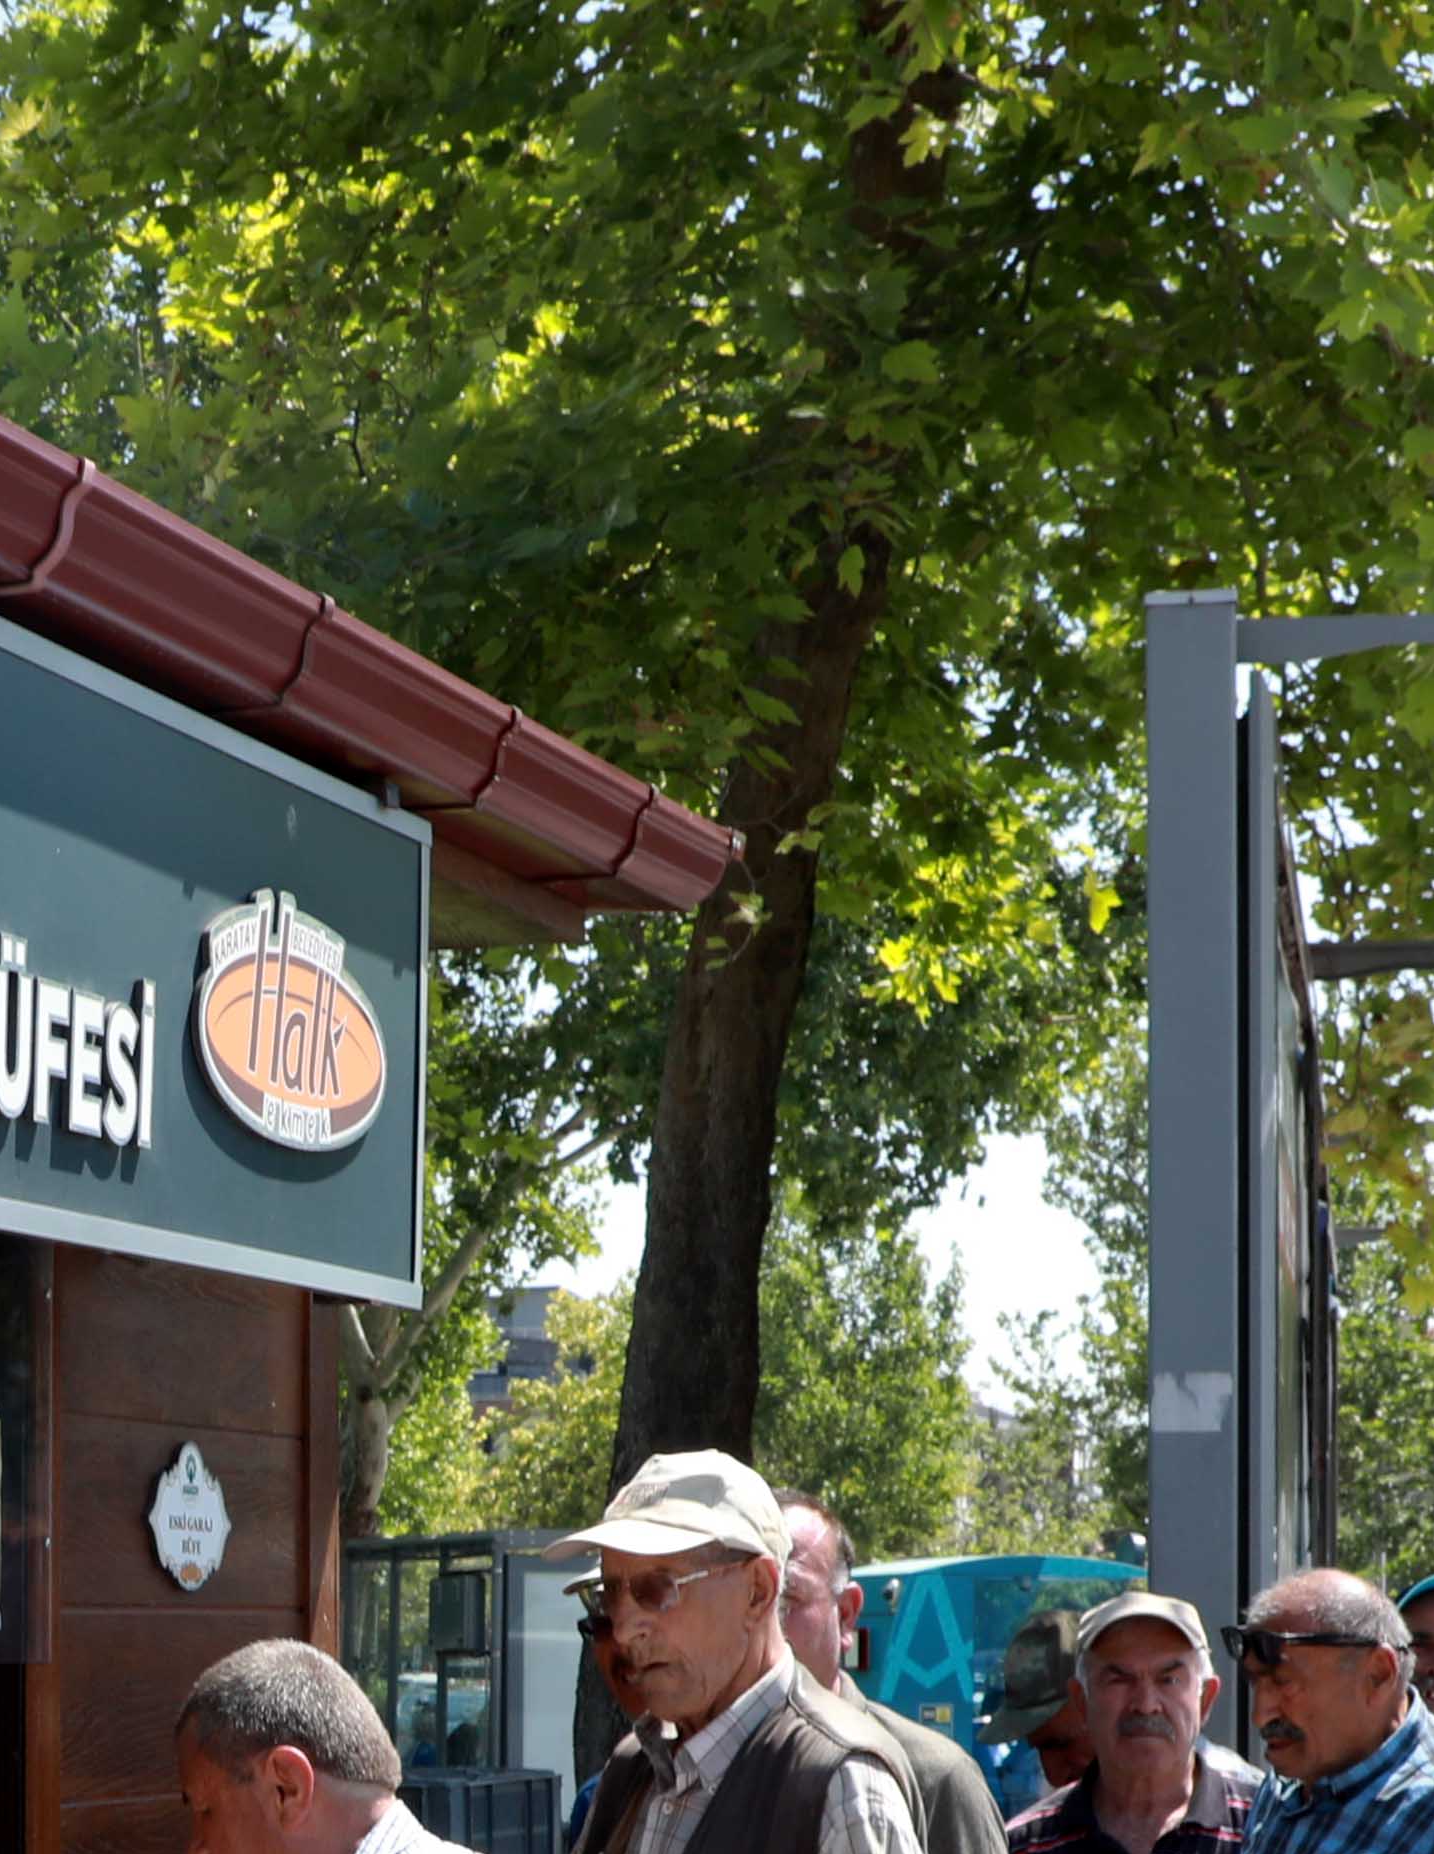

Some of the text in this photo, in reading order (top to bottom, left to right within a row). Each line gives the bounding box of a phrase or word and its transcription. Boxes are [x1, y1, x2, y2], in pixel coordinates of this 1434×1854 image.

[215, 922, 257, 966] KARATAY
[249, 908, 344, 1096] Halk
[266, 1098, 331, 1138] ekmek
